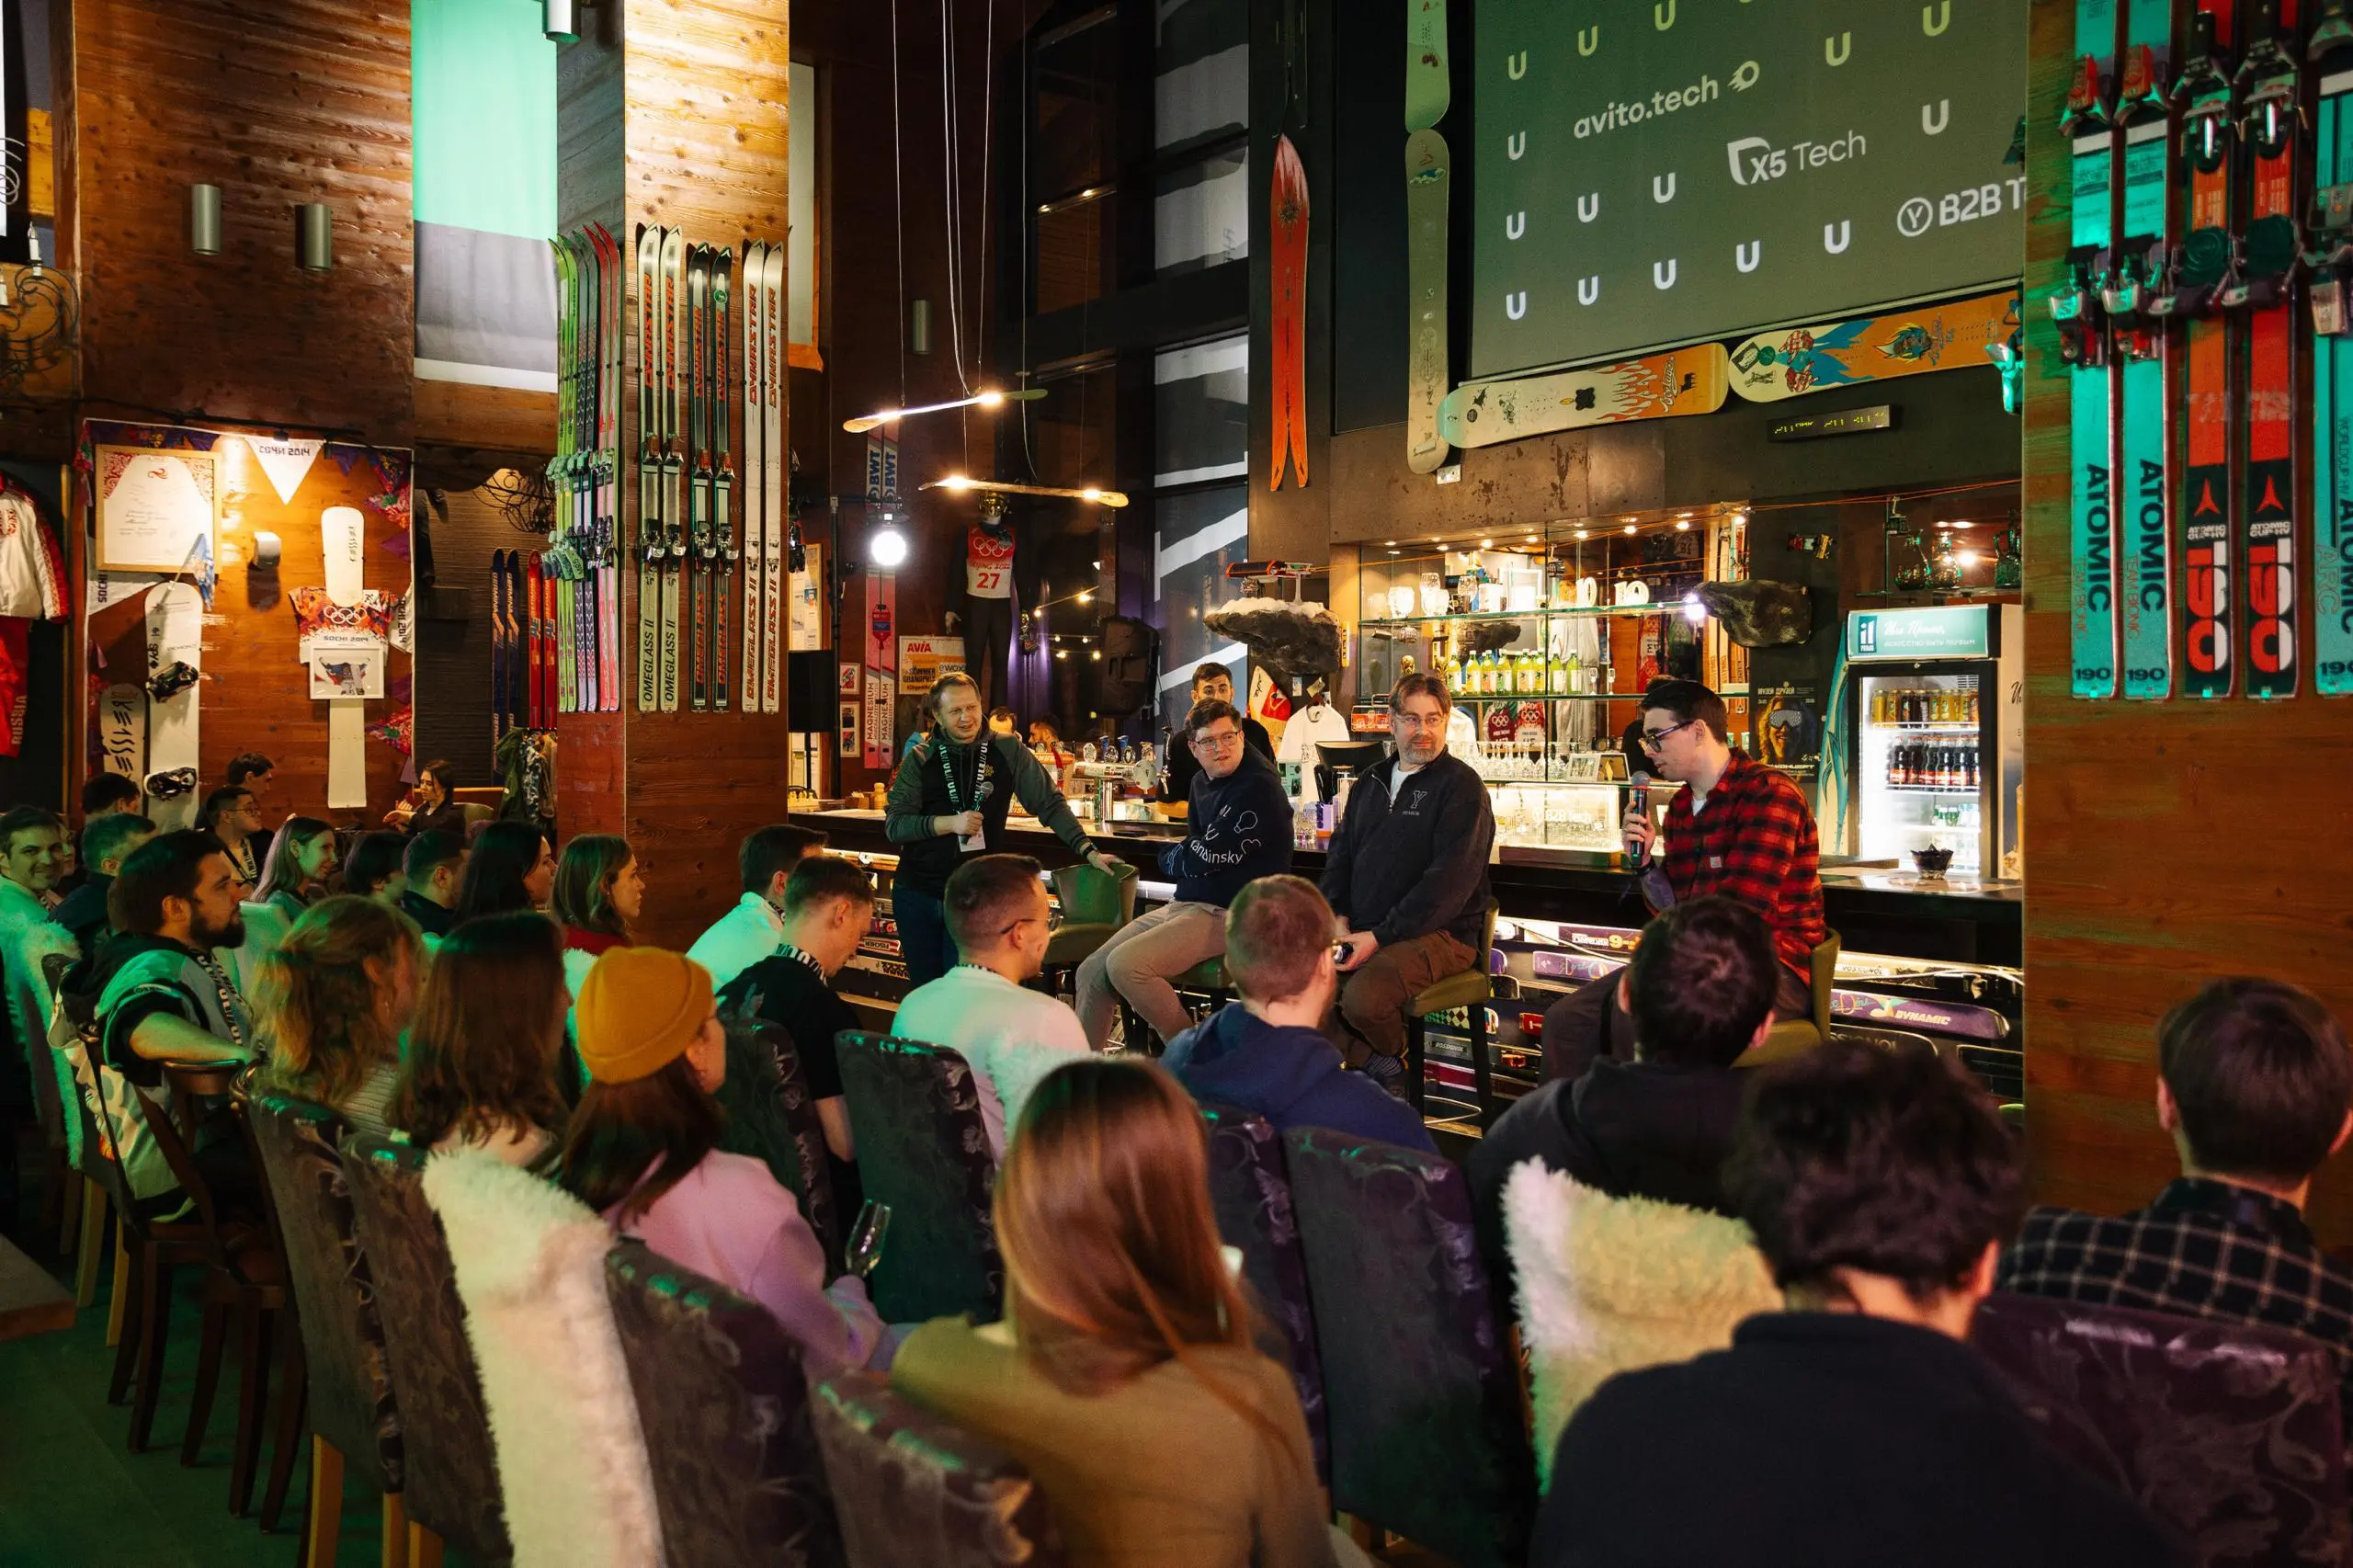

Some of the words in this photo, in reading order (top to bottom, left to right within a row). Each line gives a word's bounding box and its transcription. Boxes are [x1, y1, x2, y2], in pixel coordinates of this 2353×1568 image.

[1654, 0, 1676, 30] U
[1923, 0, 1950, 37] U
[1578, 26, 1598, 56] U
[1825, 31, 1851, 66] U
[1508, 51, 1527, 80] U
[1574, 74, 1719, 139] avito.tech
[1922, 98, 1949, 135] U
[1507, 131, 1526, 161] U
[1750, 149, 1787, 185] X5
[1793, 130, 1866, 171] Tech
[1654, 173, 1676, 203] U
[1939, 184, 2002, 226] B2B
[2006, 176, 2027, 210] T
[1578, 193, 1598, 223] U
[1506, 211, 1525, 240] U
[1824, 221, 1850, 254] U
[1736, 241, 1760, 273] U
[1654, 259, 1677, 290] U
[1506, 291, 1526, 320] U
[1578, 276, 1598, 305] U
[768, 287, 777, 408] DYNASTAR
[259, 446, 285, 455] СОЧИ
[288, 448, 311, 456] 2014
[870, 449, 880, 485] BWT
[885, 452, 896, 487] BWT
[2086, 463, 2110, 612] ATOMIC
[2140, 459, 2165, 611] ATOMIC
[2188, 525, 2226, 534] ATOMIC
[2250, 521, 2291, 530] ATOMIC
[749, 577, 756, 591] II
[769, 578, 777, 593] II
[976, 573, 1000, 588] 27
[2074, 557, 2086, 590] TEAM
[2126, 555, 2139, 590] TEAM
[98, 574, 107, 602] SOCHI
[1576, 576, 1597, 607] 10
[1614, 580, 1649, 606] 10
[398, 622, 407, 642] 2014
[644, 619, 654, 629] II
[665, 619, 676, 629] II
[747, 594, 756, 699] OMEGLASS
[767, 597, 777, 700] OMEGLASS
[907, 642, 932, 653] AVIA
[644, 631, 654, 702] OMEGLASS
[665, 631, 676, 702] OMEGLASS
[2074, 667, 2111, 681] 190
[2126, 667, 2165, 681] 190
[11, 695, 28, 744] RUSSIA
[109, 699, 136, 781] ESSLER
[1894, 1009, 1952, 1026] DYNAMIC
